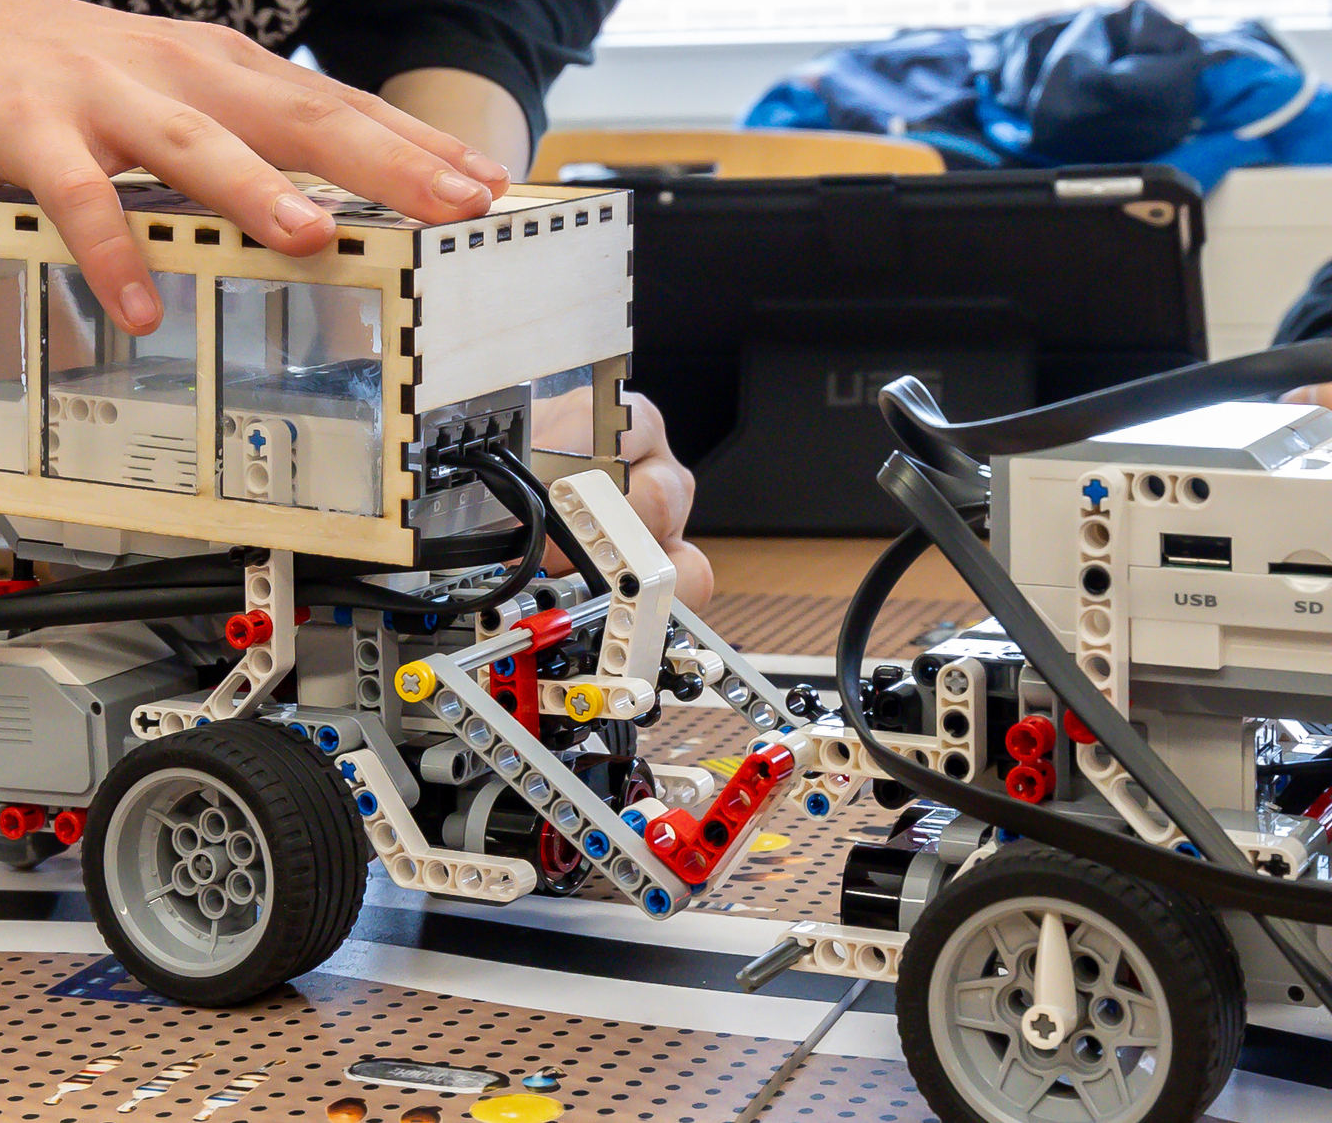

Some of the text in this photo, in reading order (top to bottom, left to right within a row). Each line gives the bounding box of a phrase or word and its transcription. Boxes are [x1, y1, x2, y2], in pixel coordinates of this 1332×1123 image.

[433, 501, 441, 512] D
[459, 493, 466, 505] C
[1174, 592, 1218, 608] USB
[1294, 600, 1324, 615] SD
